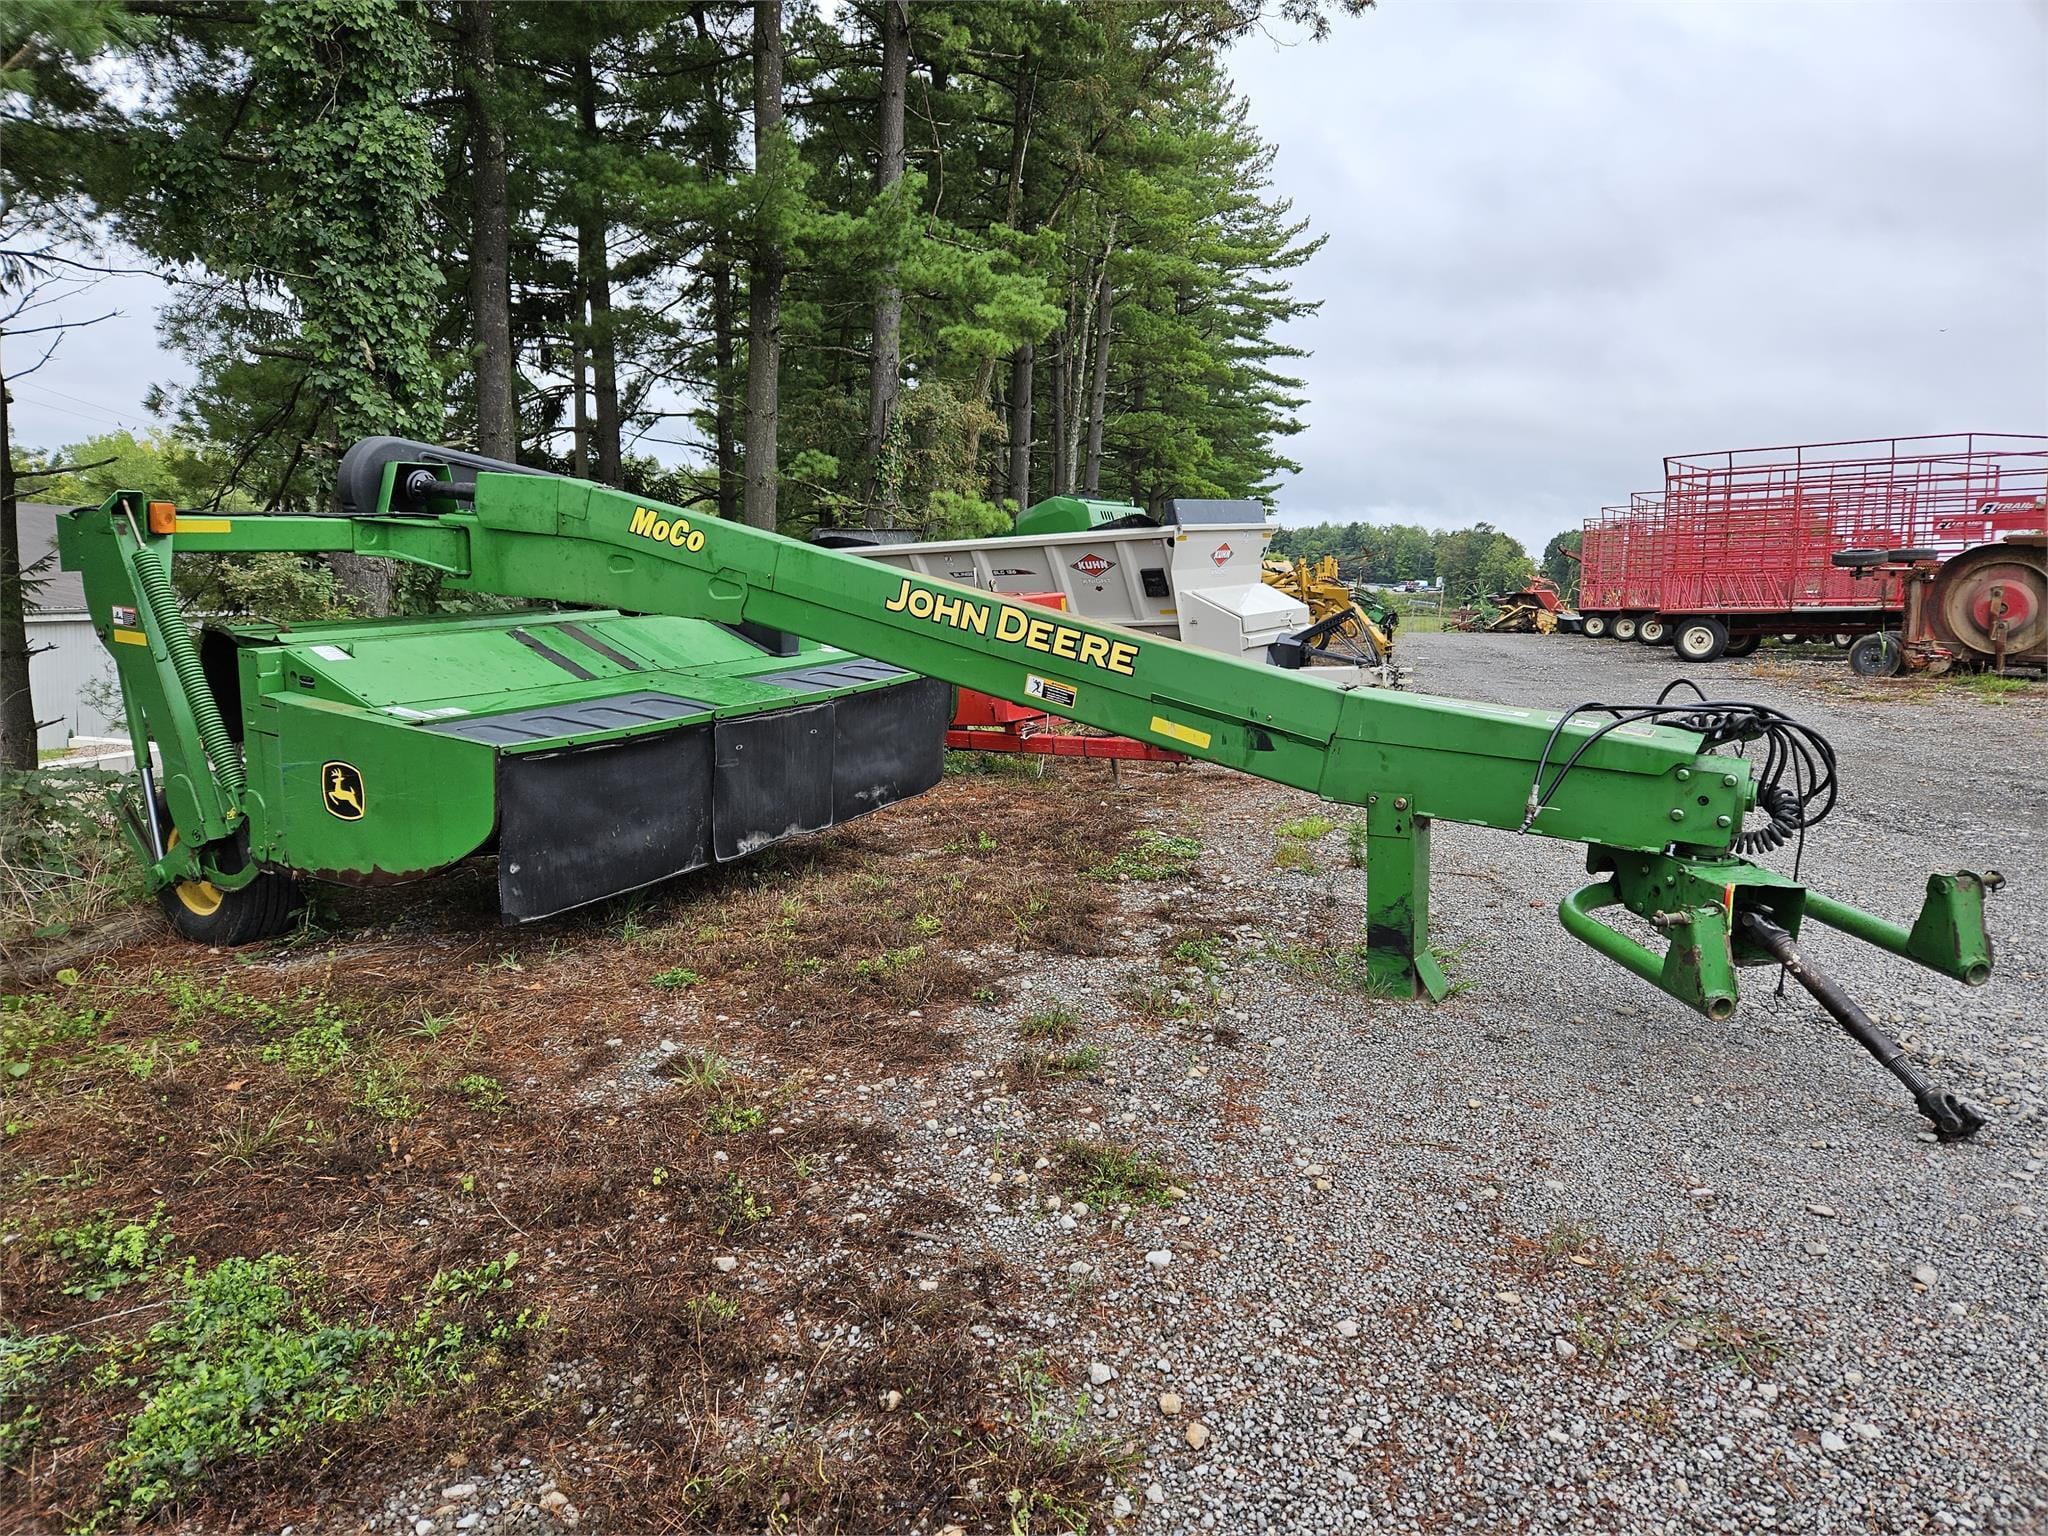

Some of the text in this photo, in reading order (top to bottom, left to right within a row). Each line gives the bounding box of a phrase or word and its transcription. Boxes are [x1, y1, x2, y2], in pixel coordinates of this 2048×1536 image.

[629, 505, 705, 552] MoCo
[1077, 560, 1109, 570] KUHN
[885, 579, 1139, 676] JOHN DEERE
